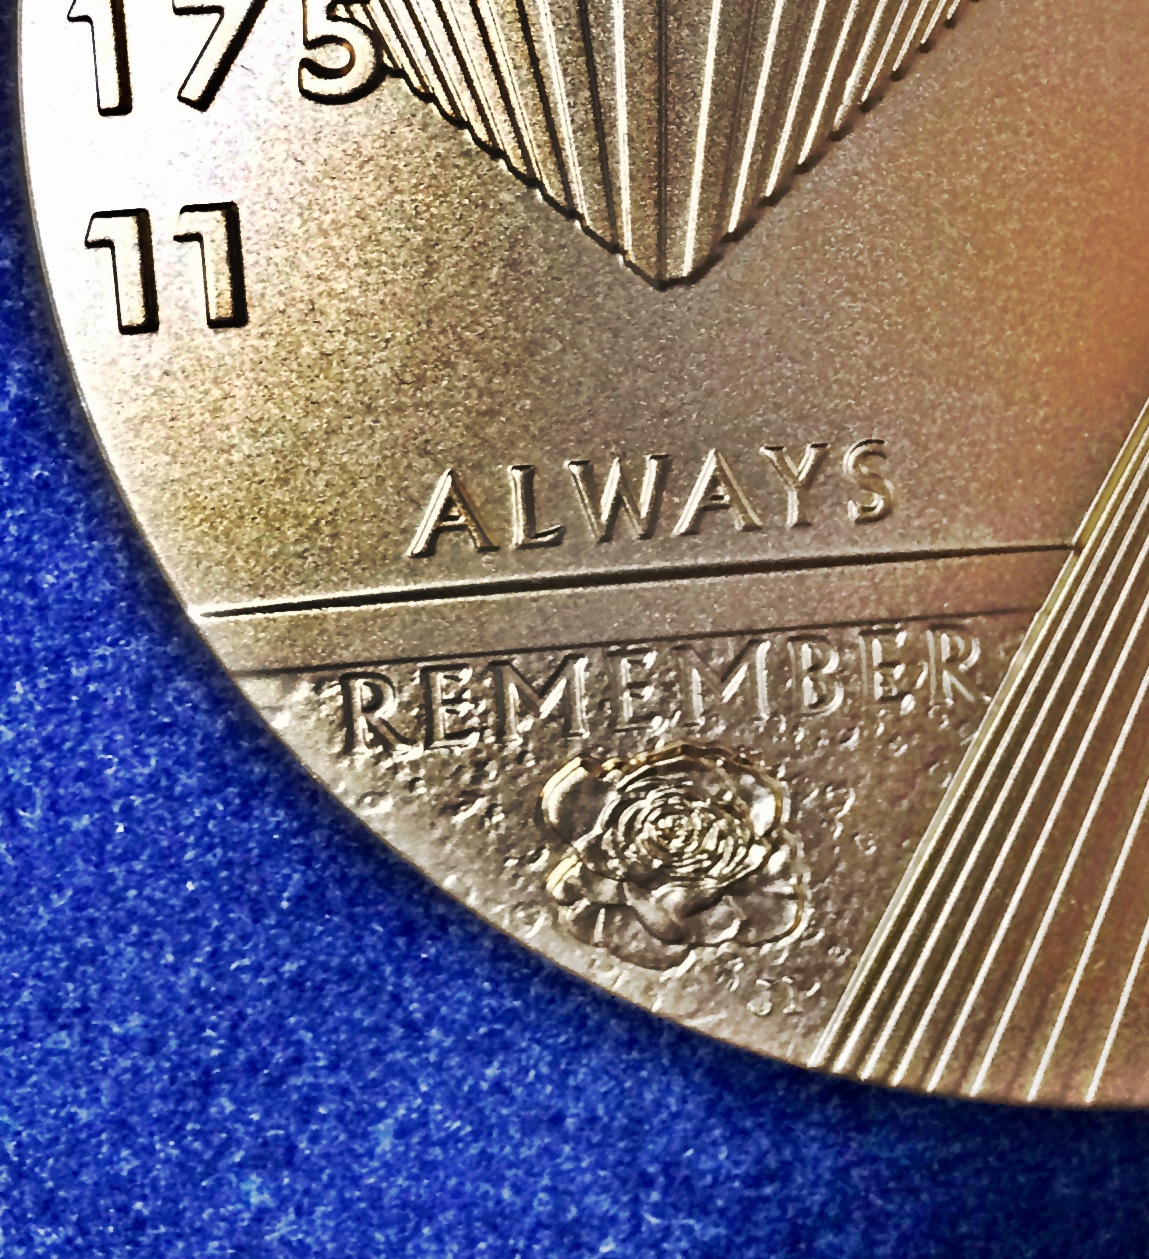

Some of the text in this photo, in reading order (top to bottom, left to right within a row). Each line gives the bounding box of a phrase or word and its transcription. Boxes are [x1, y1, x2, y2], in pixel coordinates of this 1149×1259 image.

[84, 201, 249, 335] 11
[406, 438, 895, 557] ALWAYS
[338, 626, 982, 755] REMEMBER
